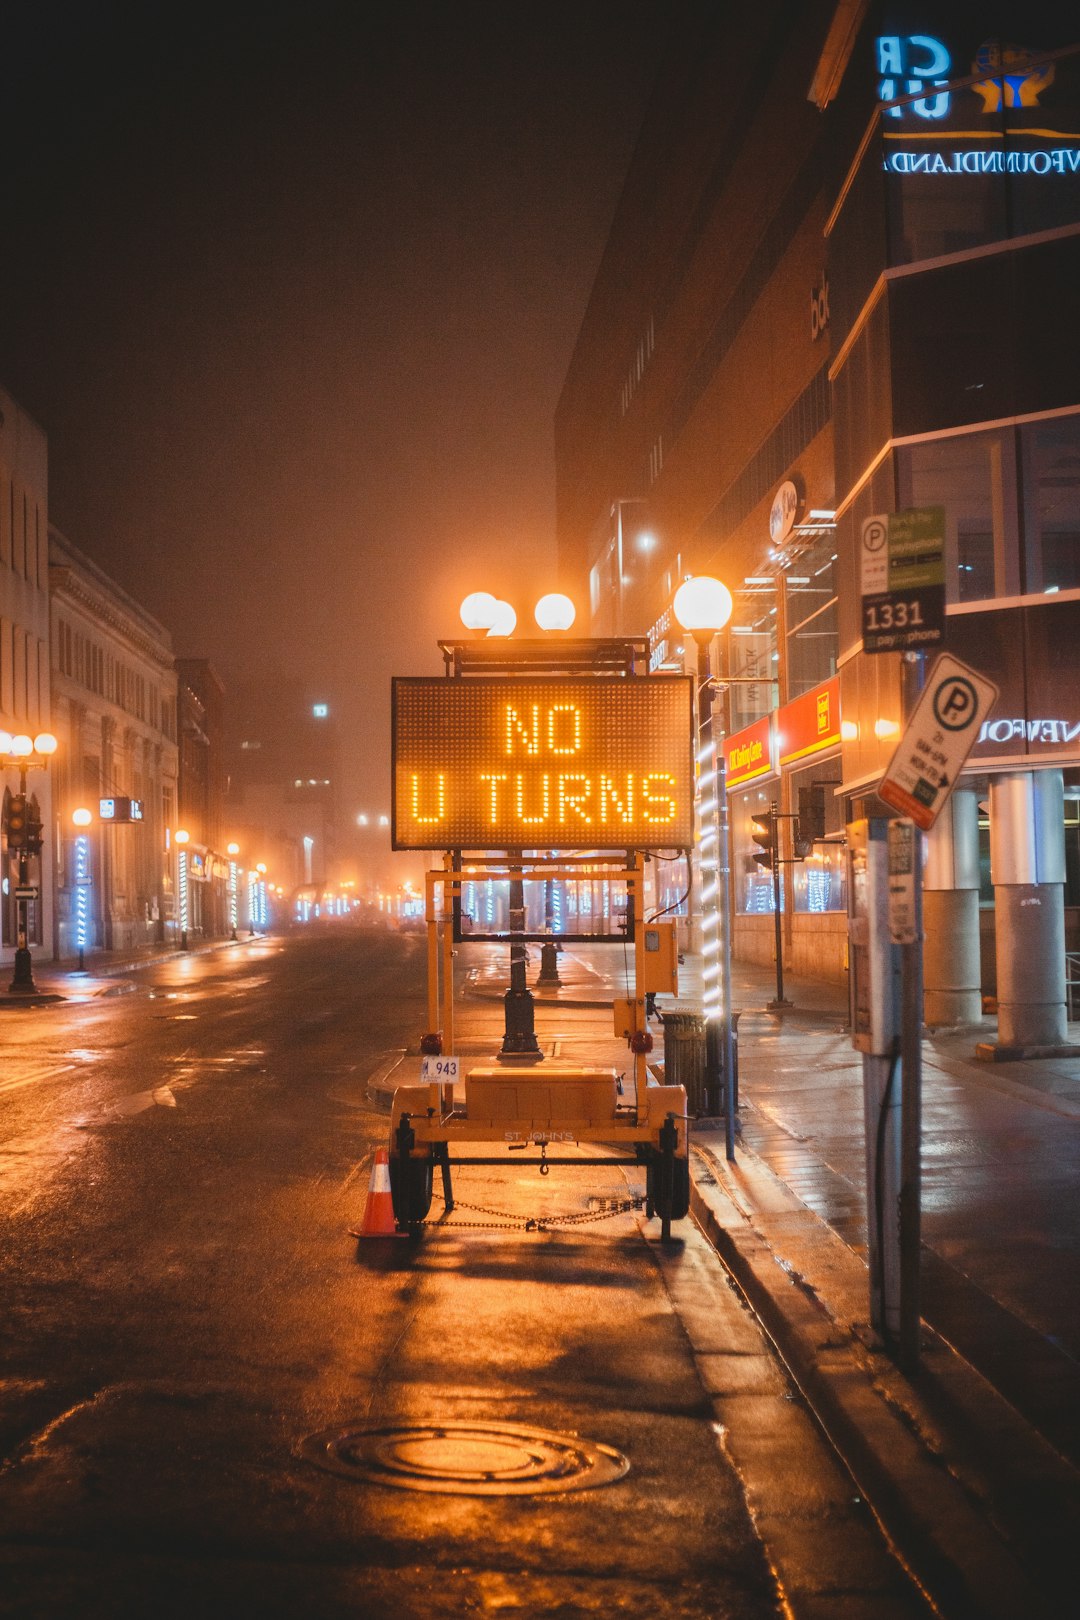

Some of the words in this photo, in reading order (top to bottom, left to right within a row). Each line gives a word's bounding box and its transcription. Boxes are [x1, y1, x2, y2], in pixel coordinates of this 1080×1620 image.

[866, 601, 924, 630] 1331
[506, 704, 581, 755] NO
[411, 774, 444, 823] U
[480, 773, 676, 823] TURNS
[436, 1062, 457, 1075] 943
[526, 1131, 574, 1141] JOHN'S
